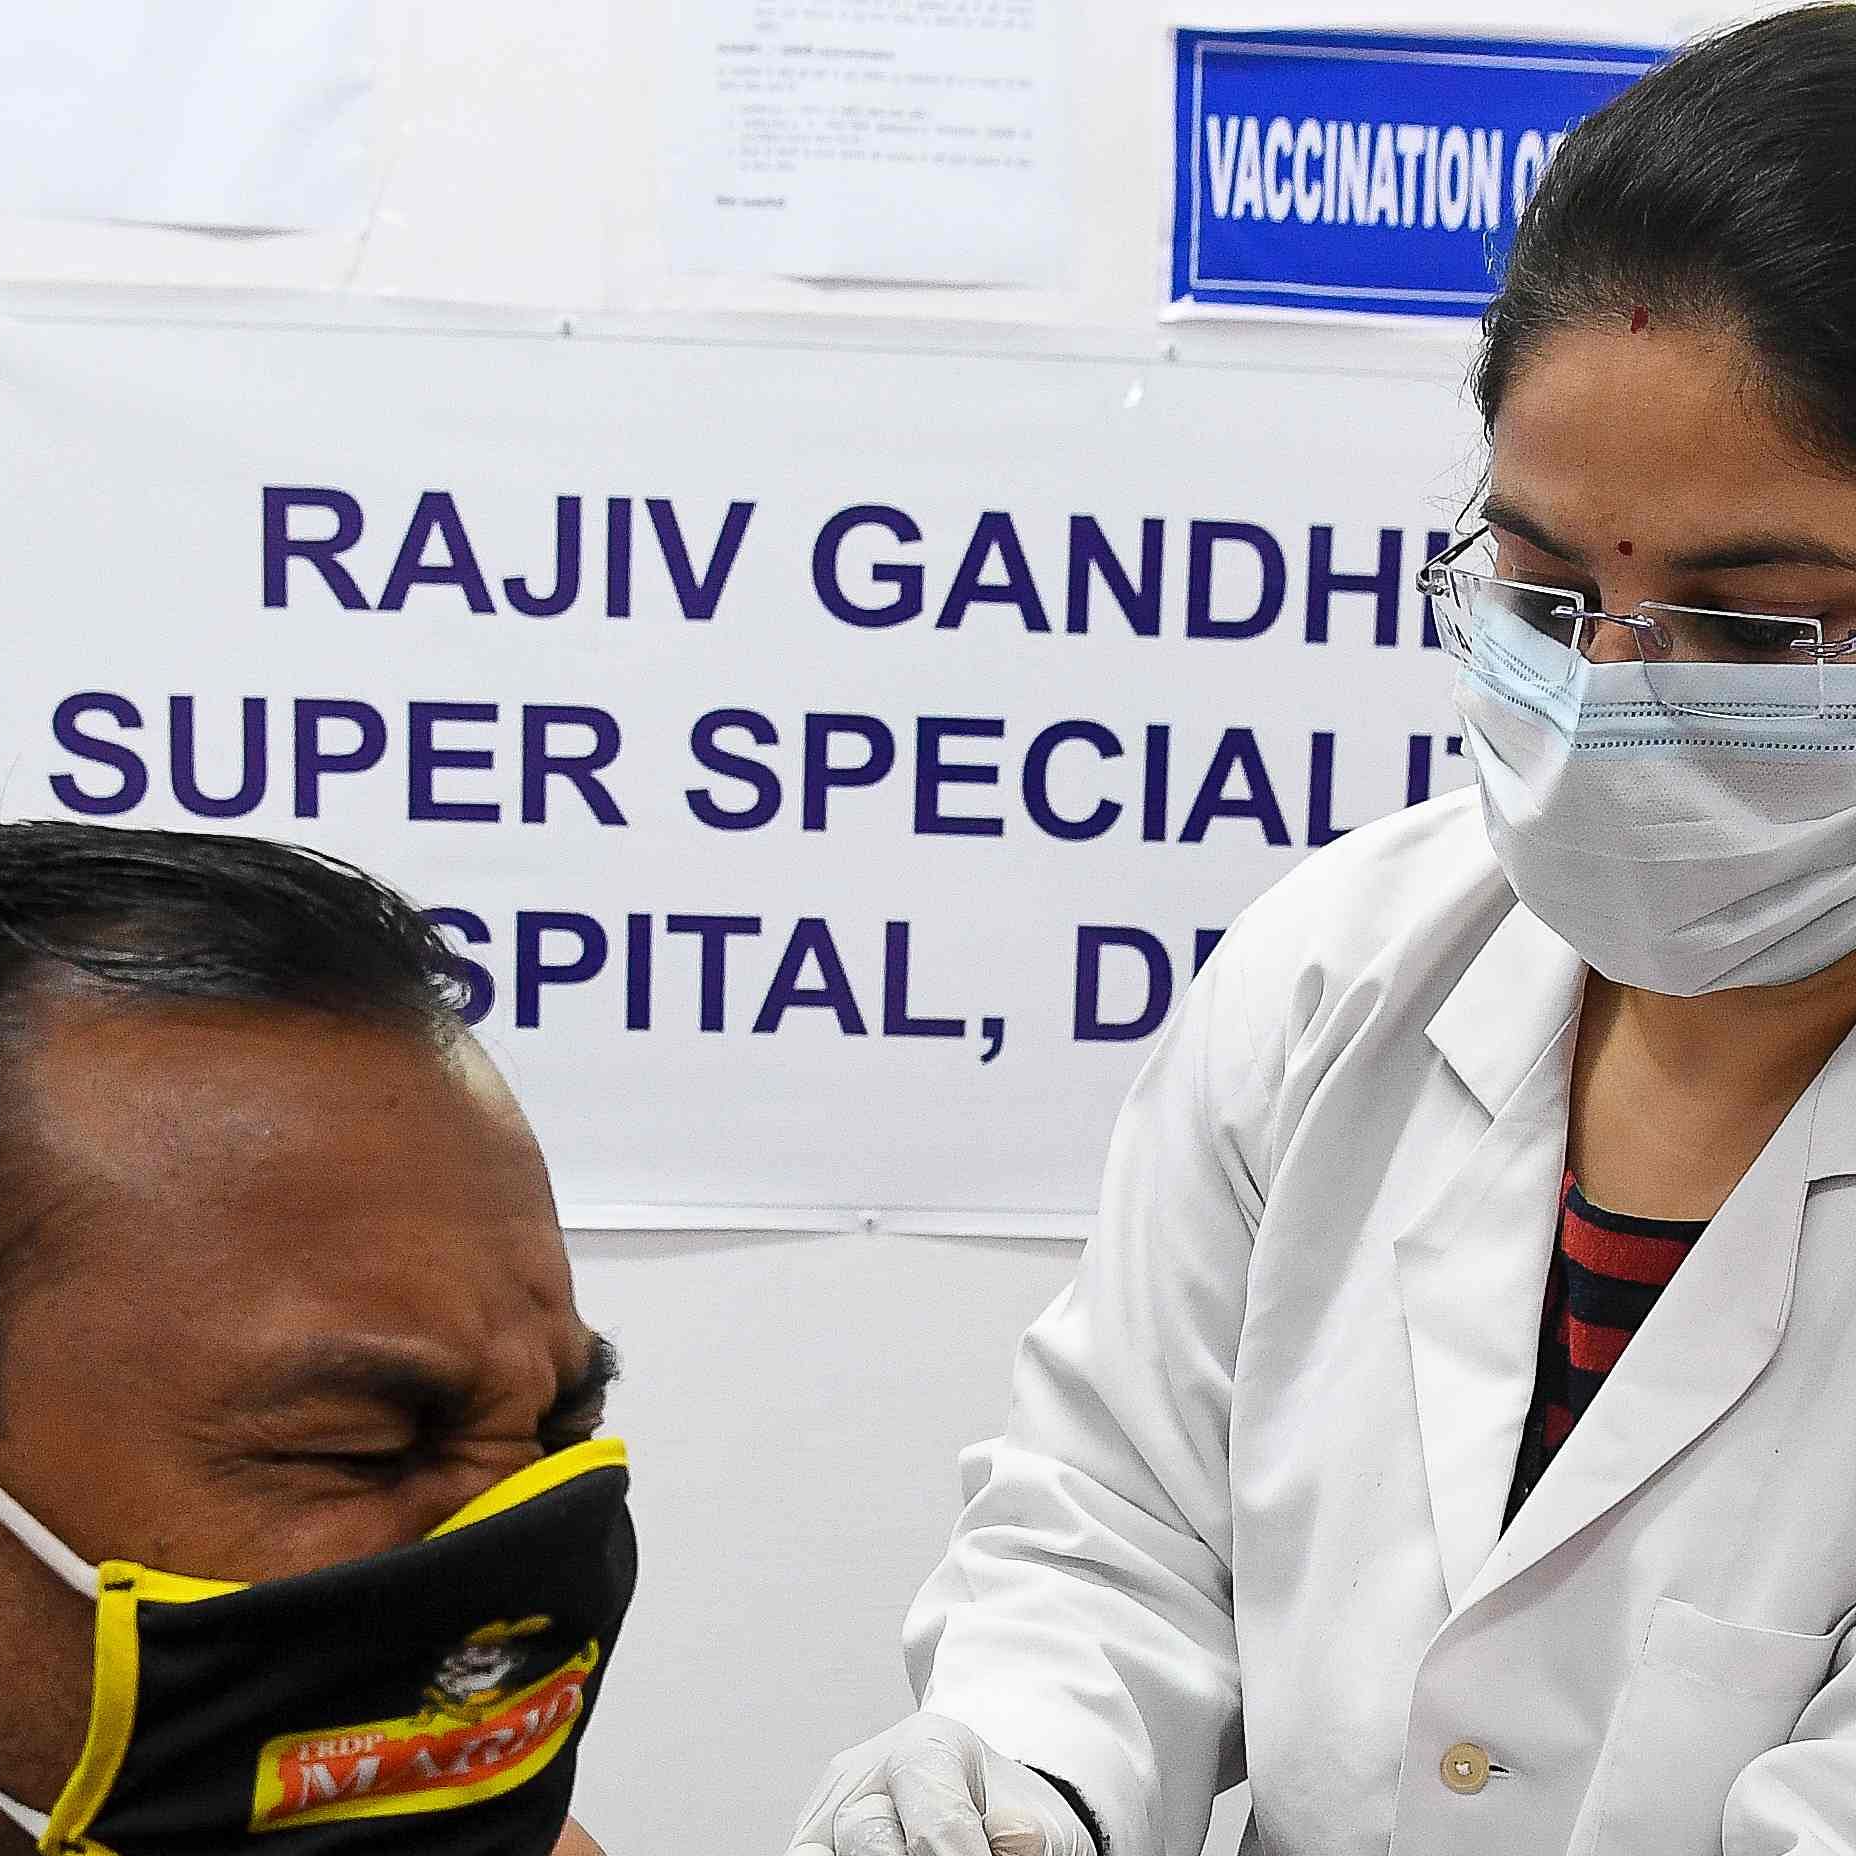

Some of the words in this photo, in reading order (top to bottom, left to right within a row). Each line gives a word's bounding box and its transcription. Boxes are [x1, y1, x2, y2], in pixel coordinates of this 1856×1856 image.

[1205, 113, 1504, 233] VACCINATION
[258, 485, 757, 623] RAJIV
[809, 504, 1452, 650] GANDHI
[47, 690, 626, 828] SUPER
[1071, 921, 1228, 1043] D
